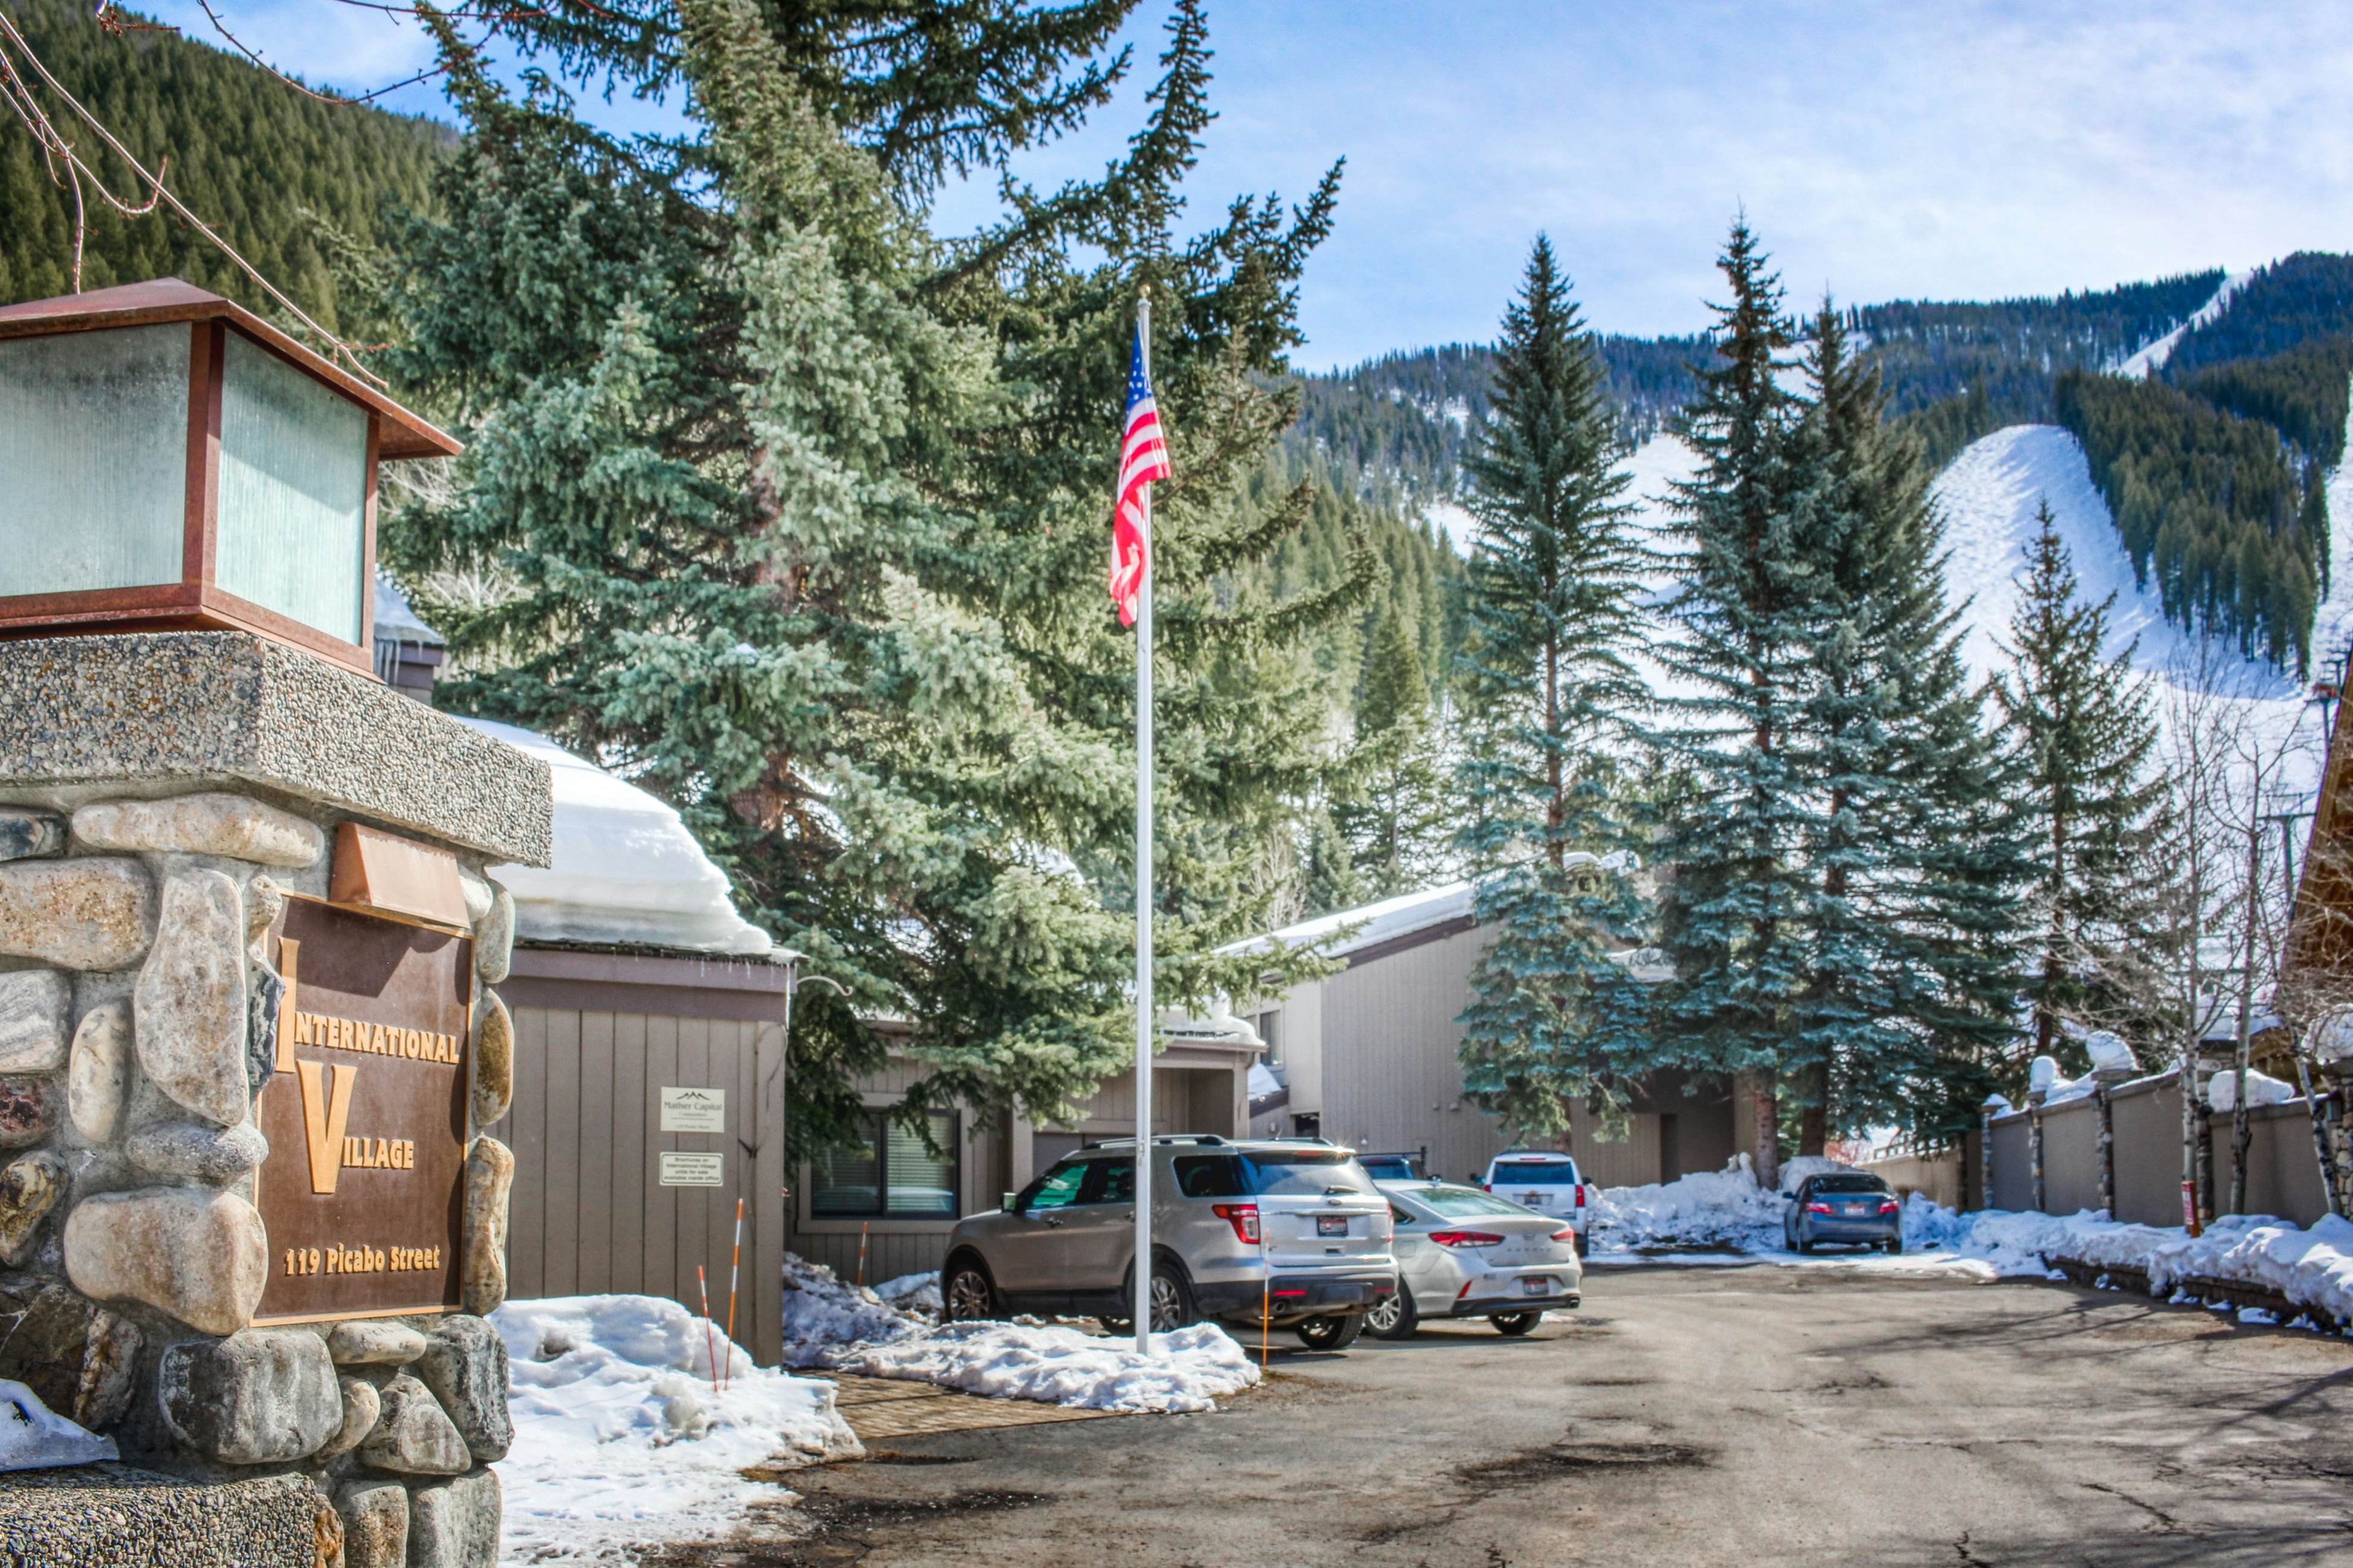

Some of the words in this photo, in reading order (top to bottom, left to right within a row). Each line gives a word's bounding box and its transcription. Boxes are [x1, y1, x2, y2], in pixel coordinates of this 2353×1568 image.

[275, 936, 460, 1073] INTERNATIONAL
[296, 1059, 415, 1195] VILLAGE
[694, 1102, 723, 1112] Capital
[285, 1248, 321, 1275] 119
[325, 1242, 386, 1275] Picabo
[389, 1245, 441, 1272] Street
